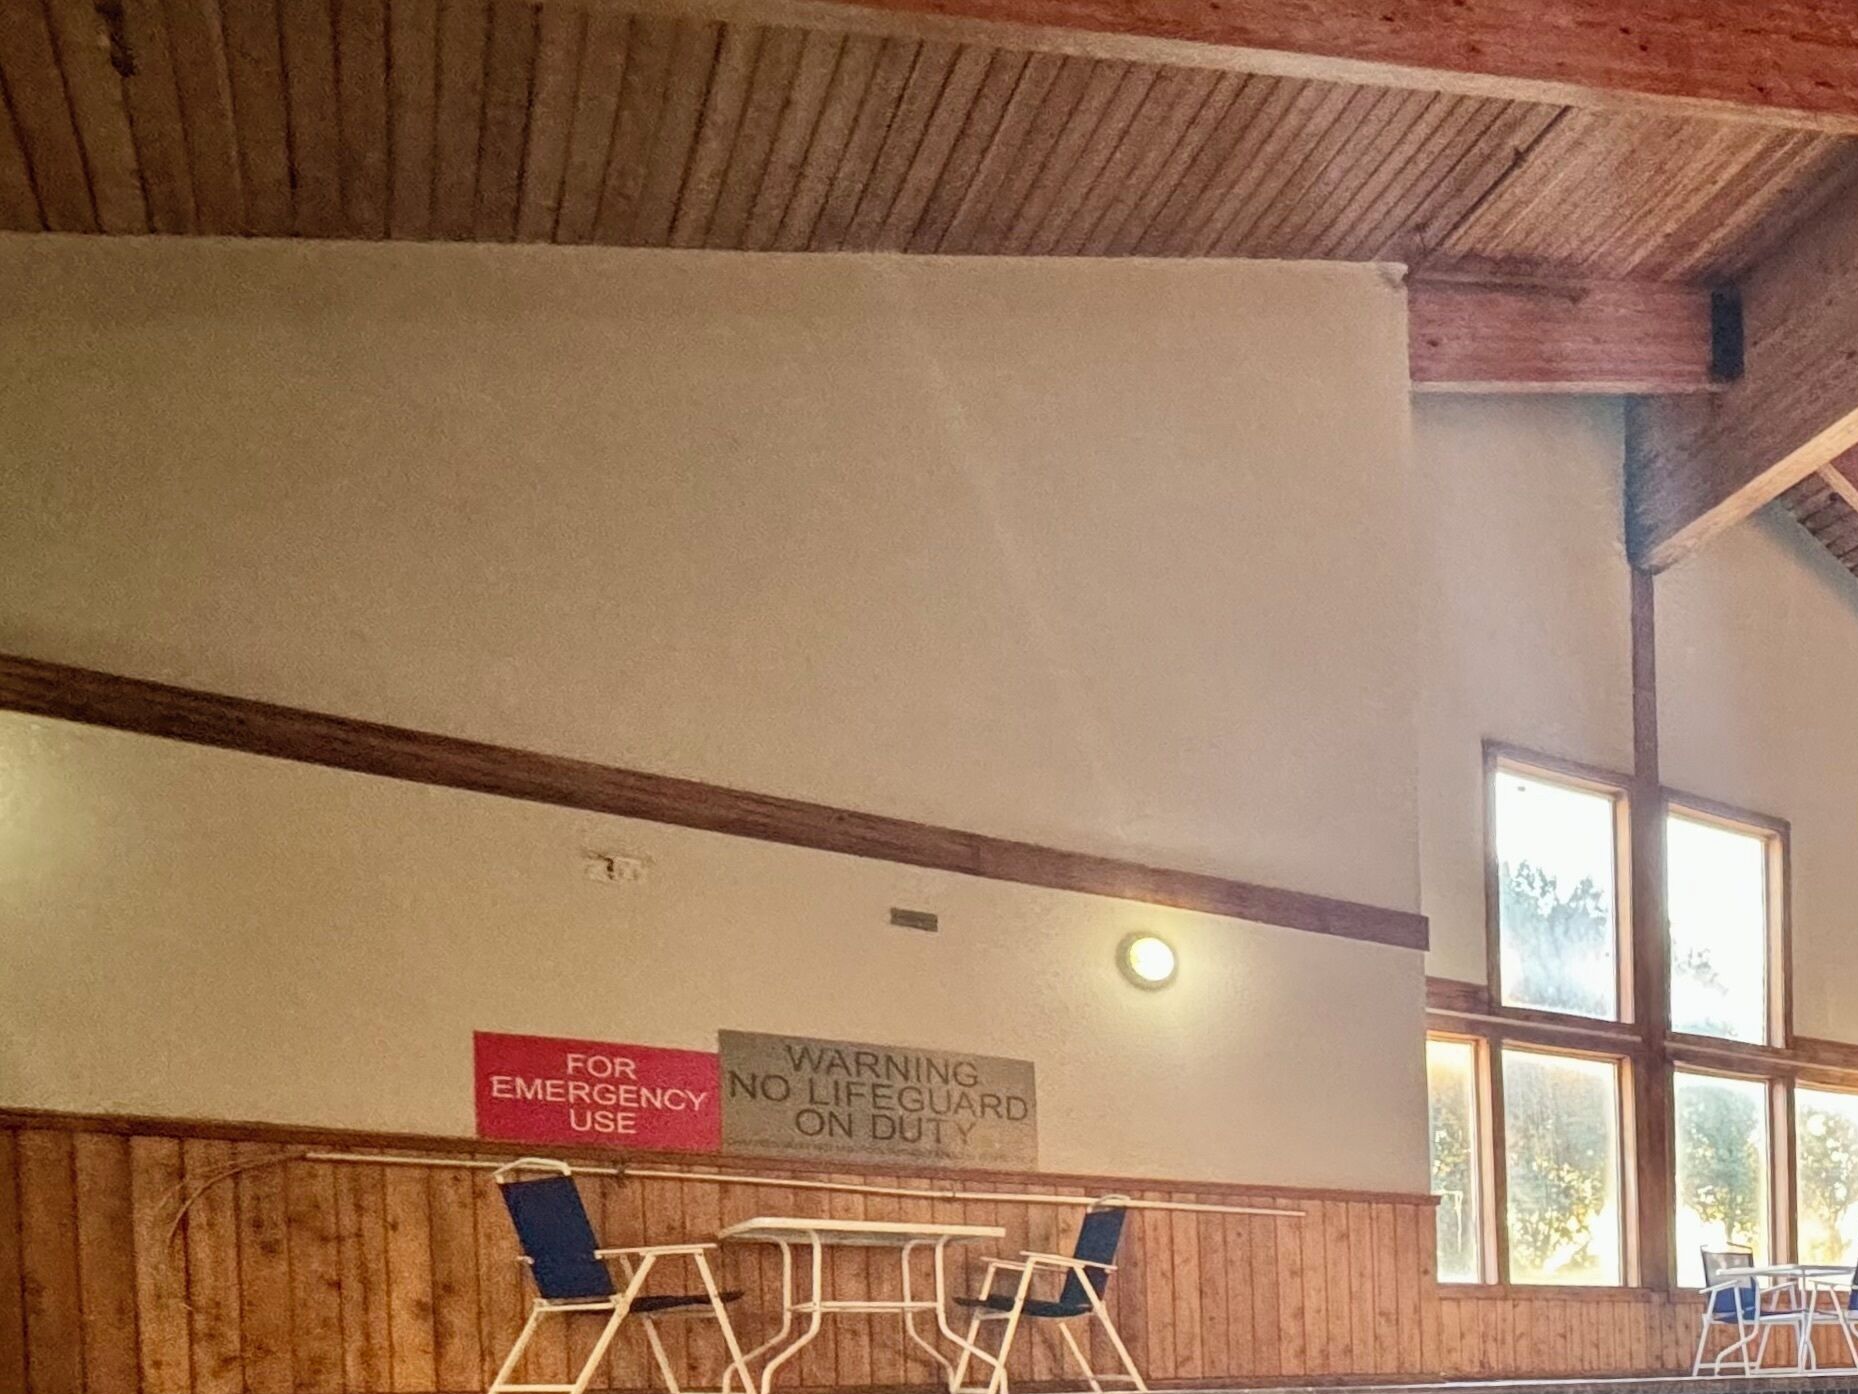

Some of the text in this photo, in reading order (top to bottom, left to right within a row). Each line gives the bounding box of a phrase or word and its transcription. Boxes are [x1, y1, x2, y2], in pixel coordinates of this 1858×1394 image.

[566, 1053, 638, 1080] FOR
[785, 1045, 979, 1088] WARNING
[490, 1075, 708, 1111] EMERGENCY
[728, 1069, 1029, 1122] NO LIFEGUARD
[569, 1107, 637, 1134] USE
[795, 1107, 977, 1146] ON DUTY
